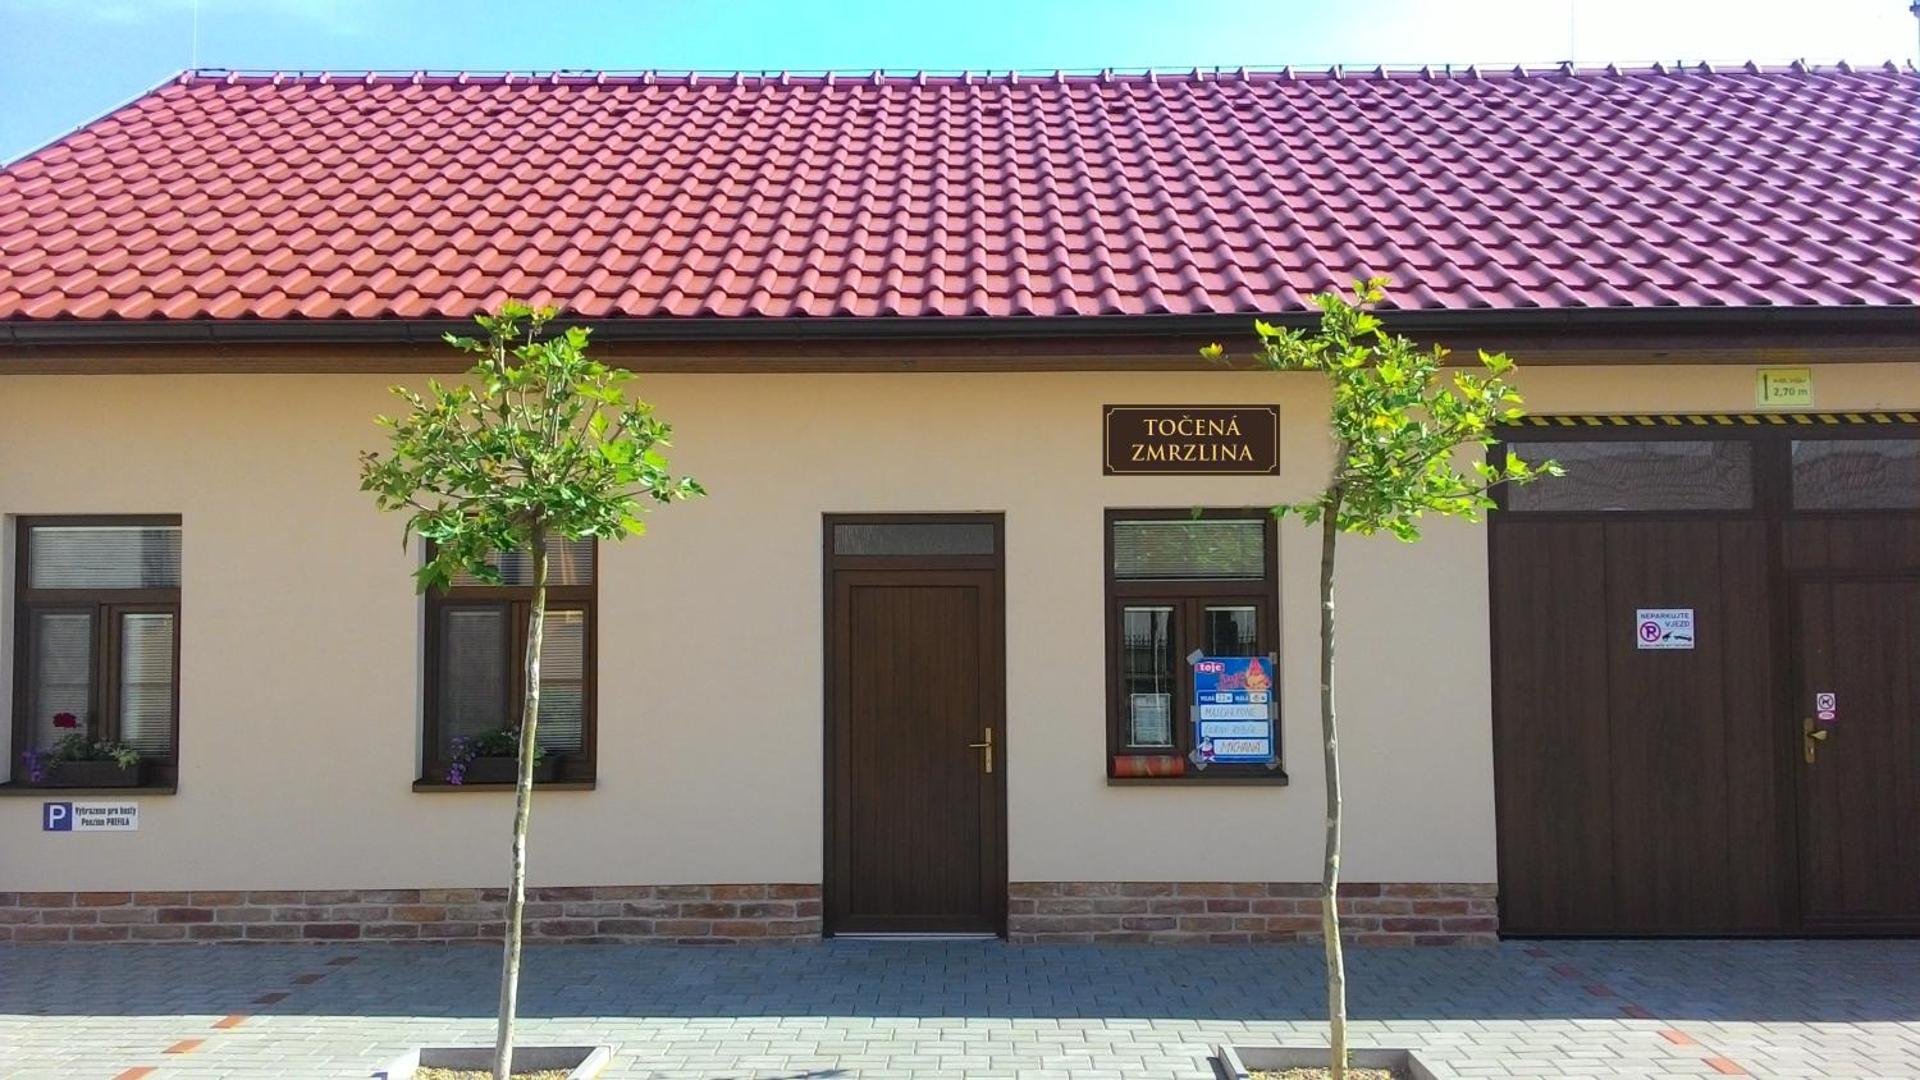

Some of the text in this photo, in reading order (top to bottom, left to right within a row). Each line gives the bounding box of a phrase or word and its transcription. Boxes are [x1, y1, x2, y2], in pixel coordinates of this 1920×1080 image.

[1773, 387, 1808, 397] 2,70 m
[1143, 415, 1242, 436] TOČENÁ
[1131, 443, 1255, 462] ZMRZLINA
[49, 804, 66, 828] P
[107, 807, 118, 817] pro
[81, 817, 105, 826] Penzion
